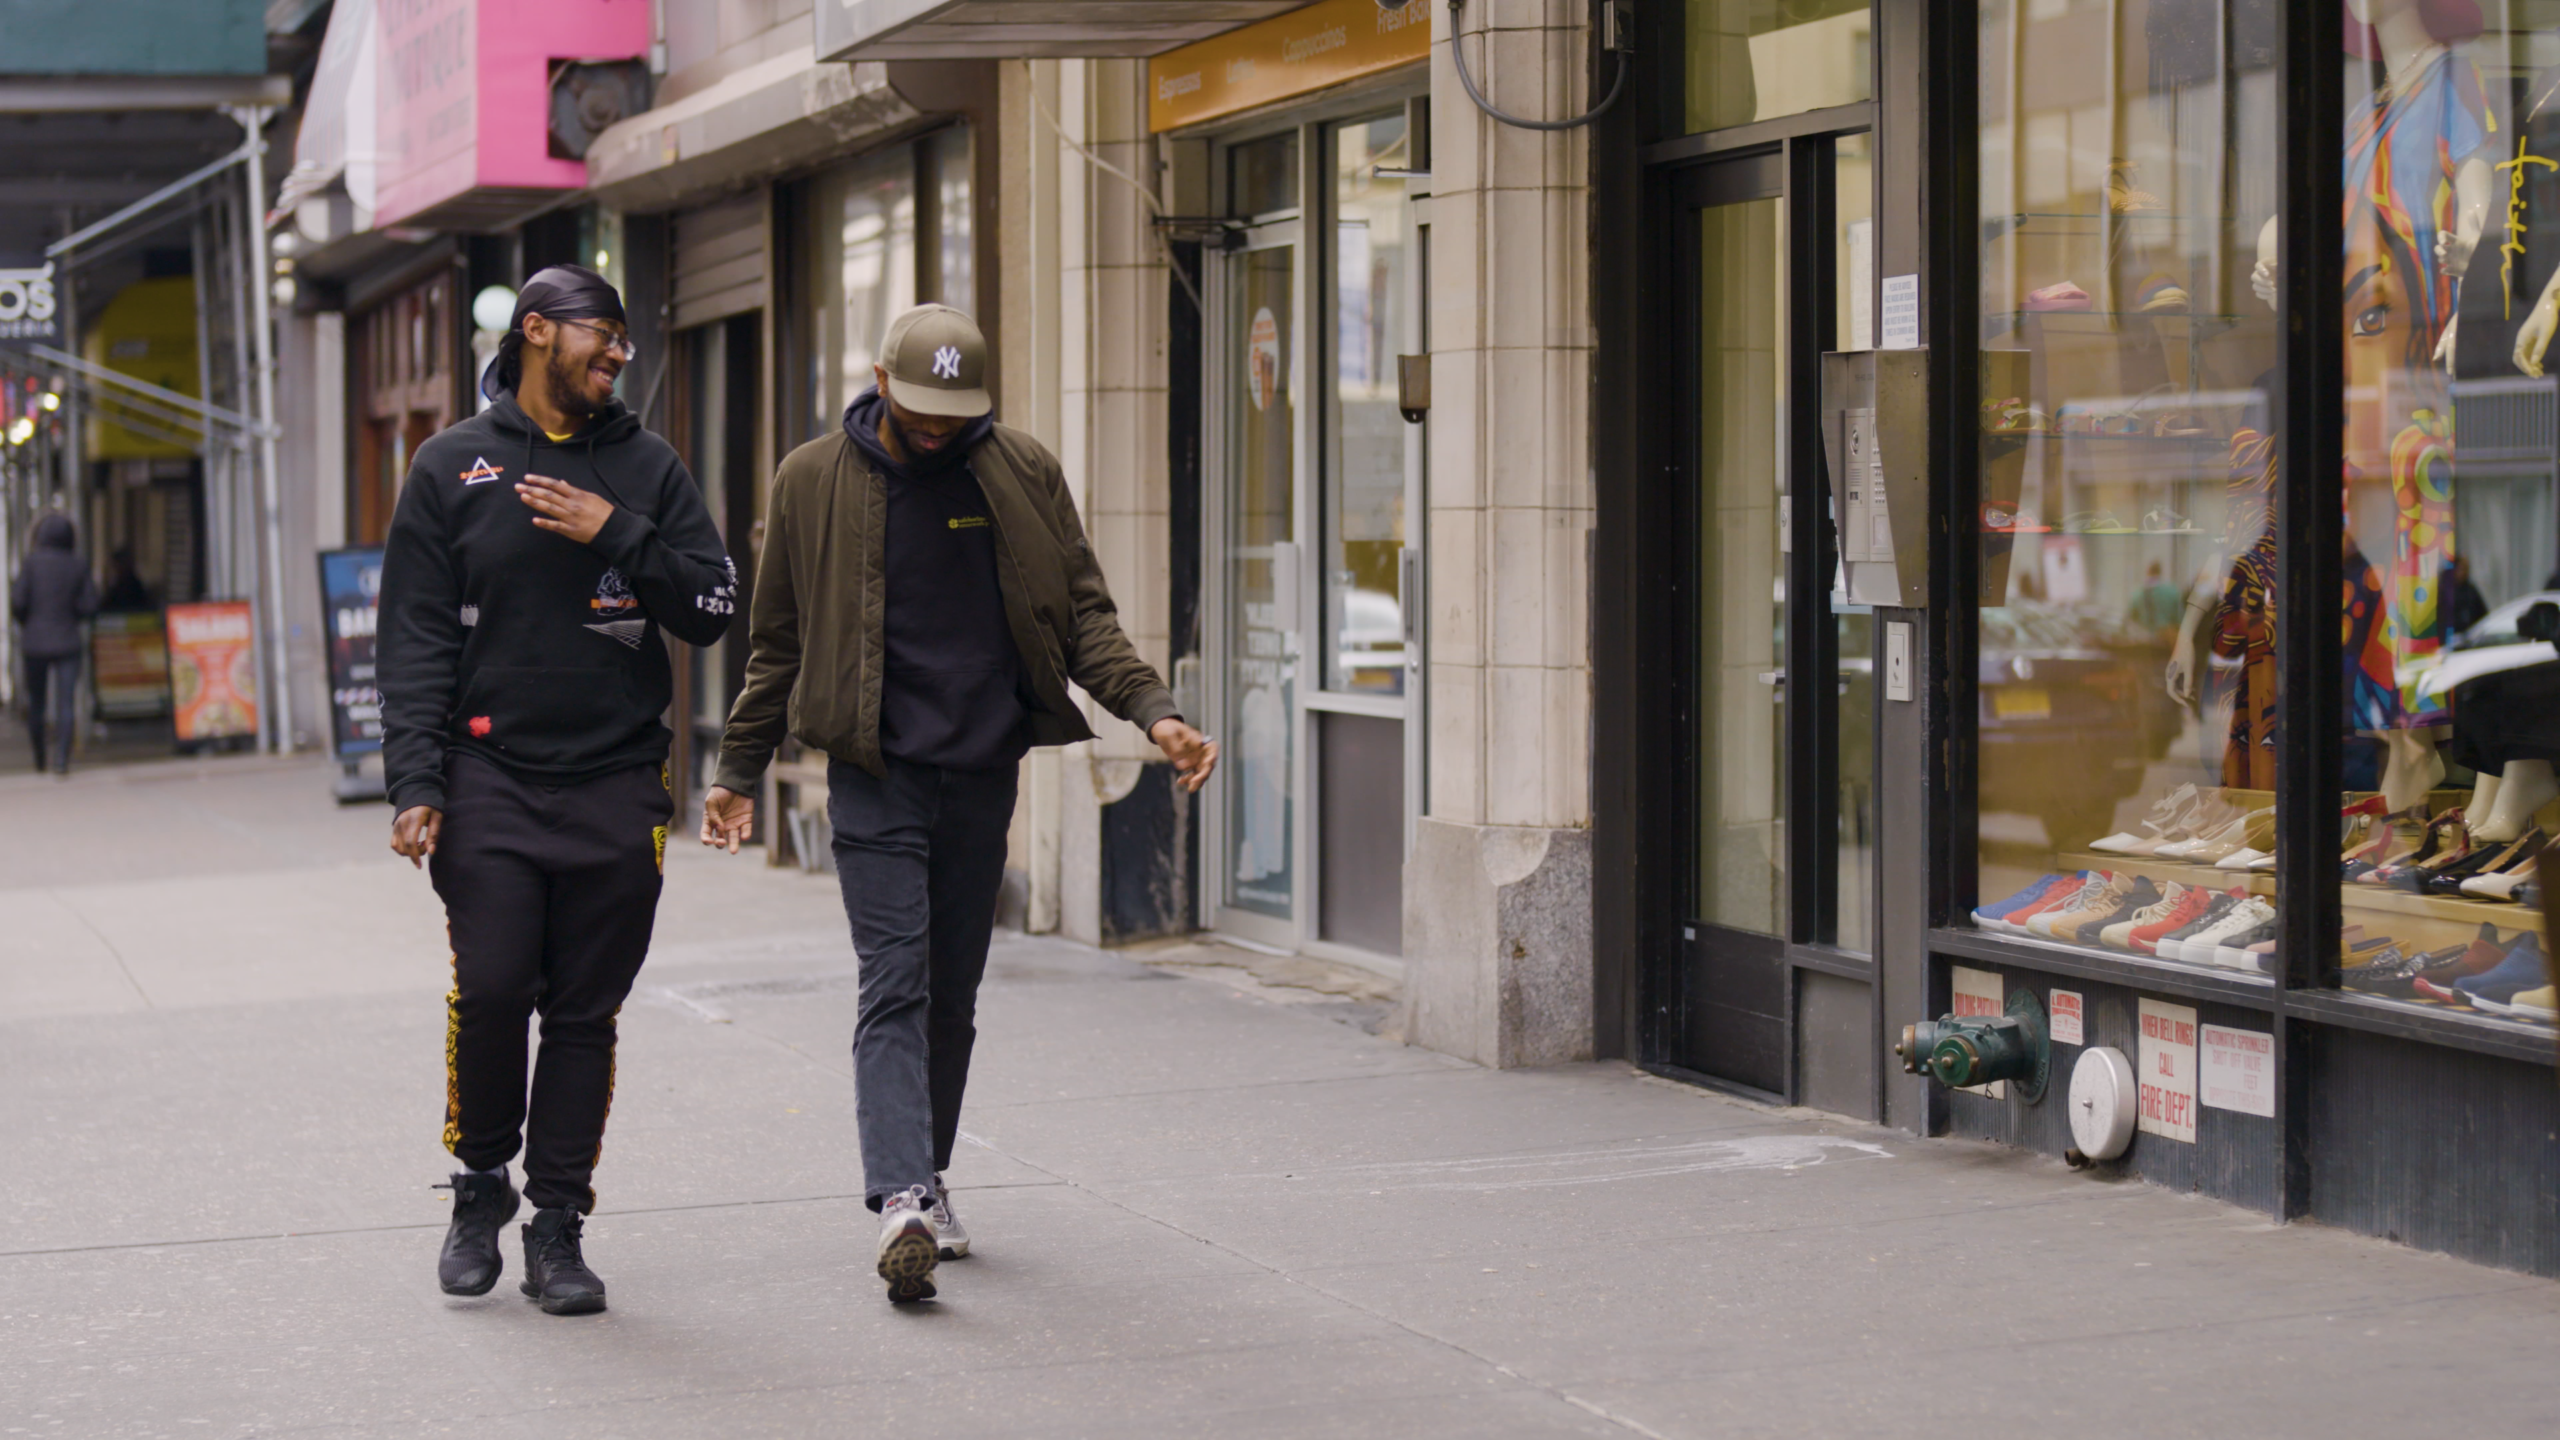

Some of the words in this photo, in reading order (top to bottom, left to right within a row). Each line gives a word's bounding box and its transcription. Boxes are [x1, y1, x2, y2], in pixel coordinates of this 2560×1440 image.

[1281, 22, 1347, 68] Cappuccinos
[932, 345, 962, 379] NY
[1954, 992, 1976, 1017] BUILDING
[2141, 1012, 2158, 1039] WHEN
[2159, 1017, 2174, 1043] BELL
[2175, 1020, 2194, 1047] RINGS
[2205, 1029, 2236, 1049] AUTOMATIC
[2237, 1034, 2269, 1055] SPRINKLER
[2158, 1051, 2174, 1077] CALL
[2212, 1049, 2227, 1067] SHUT
[2230, 1052, 2242, 1069] OFF
[2243, 1054, 2261, 1072] VALVE
[2243, 1074, 2258, 1090] FEET
[2140, 1083, 2162, 1121] FIRE
[2165, 1089, 2193, 1129] DEPT.
